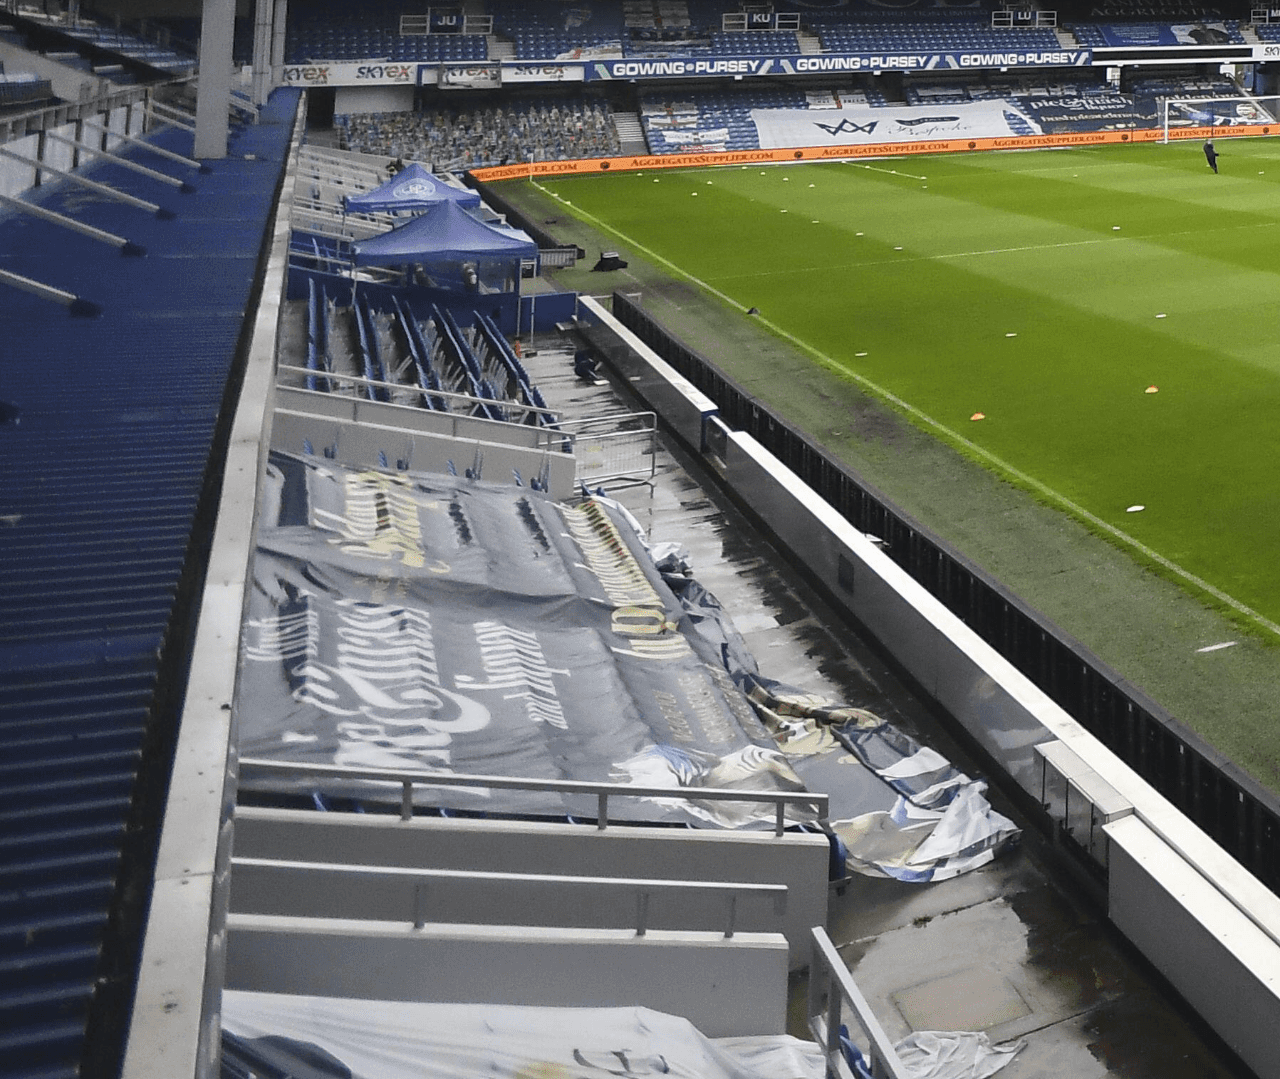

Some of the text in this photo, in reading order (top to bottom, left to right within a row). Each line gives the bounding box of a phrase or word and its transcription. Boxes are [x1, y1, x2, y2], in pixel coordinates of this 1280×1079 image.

[752, 13, 771, 23] KU
[796, 56, 928, 71] GOWING PURSEY
[960, 52, 1077, 66] GOWING PURSEY
[612, 59, 760, 77] GOWING PURSEY
